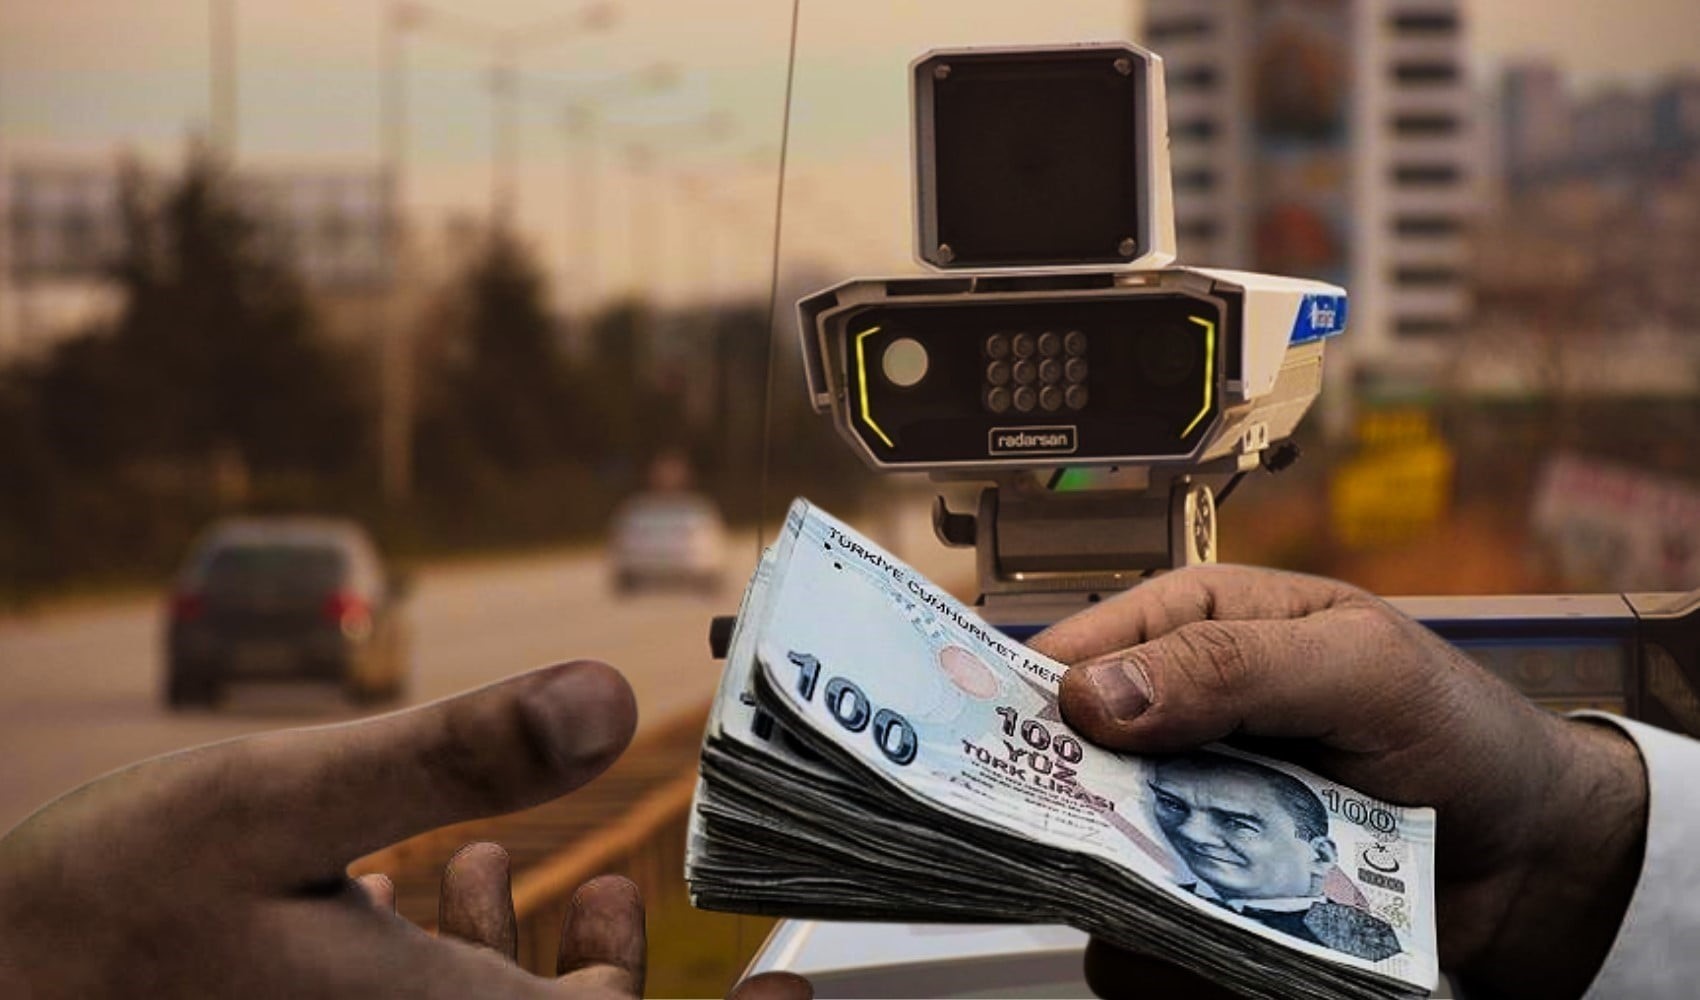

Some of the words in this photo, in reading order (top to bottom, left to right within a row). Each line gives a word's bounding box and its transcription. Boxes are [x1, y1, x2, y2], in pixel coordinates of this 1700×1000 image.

[998, 431, 1068, 448] radarsan
[787, 650, 918, 767] 100
[995, 706, 1084, 765] 100
[1322, 788, 1397, 834] 100
